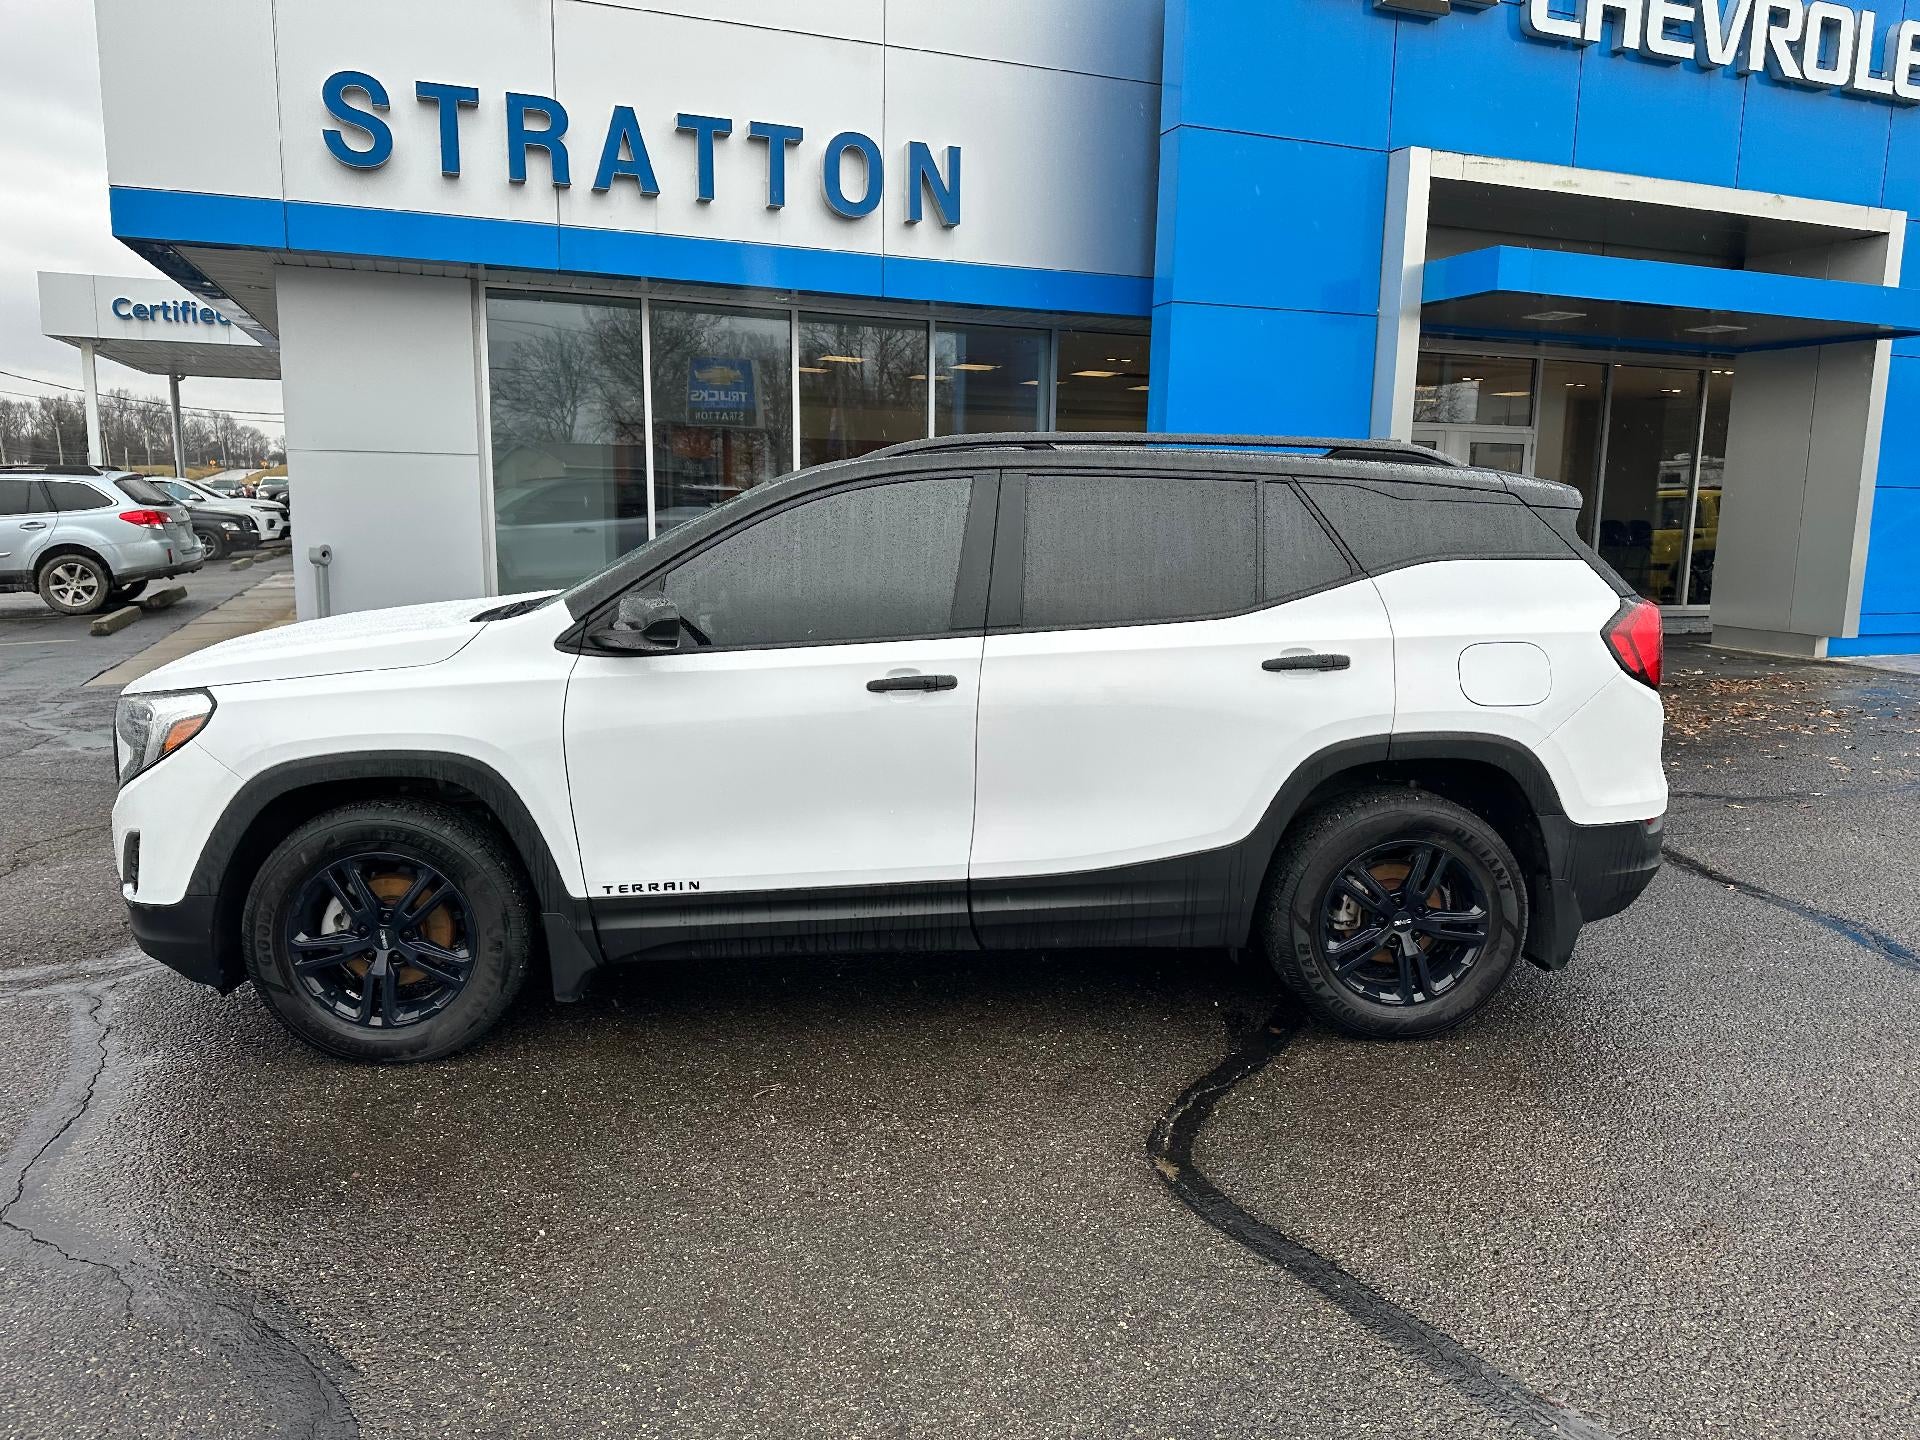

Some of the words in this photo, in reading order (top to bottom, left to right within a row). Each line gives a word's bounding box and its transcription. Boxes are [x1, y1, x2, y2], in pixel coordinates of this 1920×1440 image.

[321, 70, 962, 229] STRATTON
[602, 880, 701, 895] TERRAIN
[1455, 827, 1513, 891] REIANT
